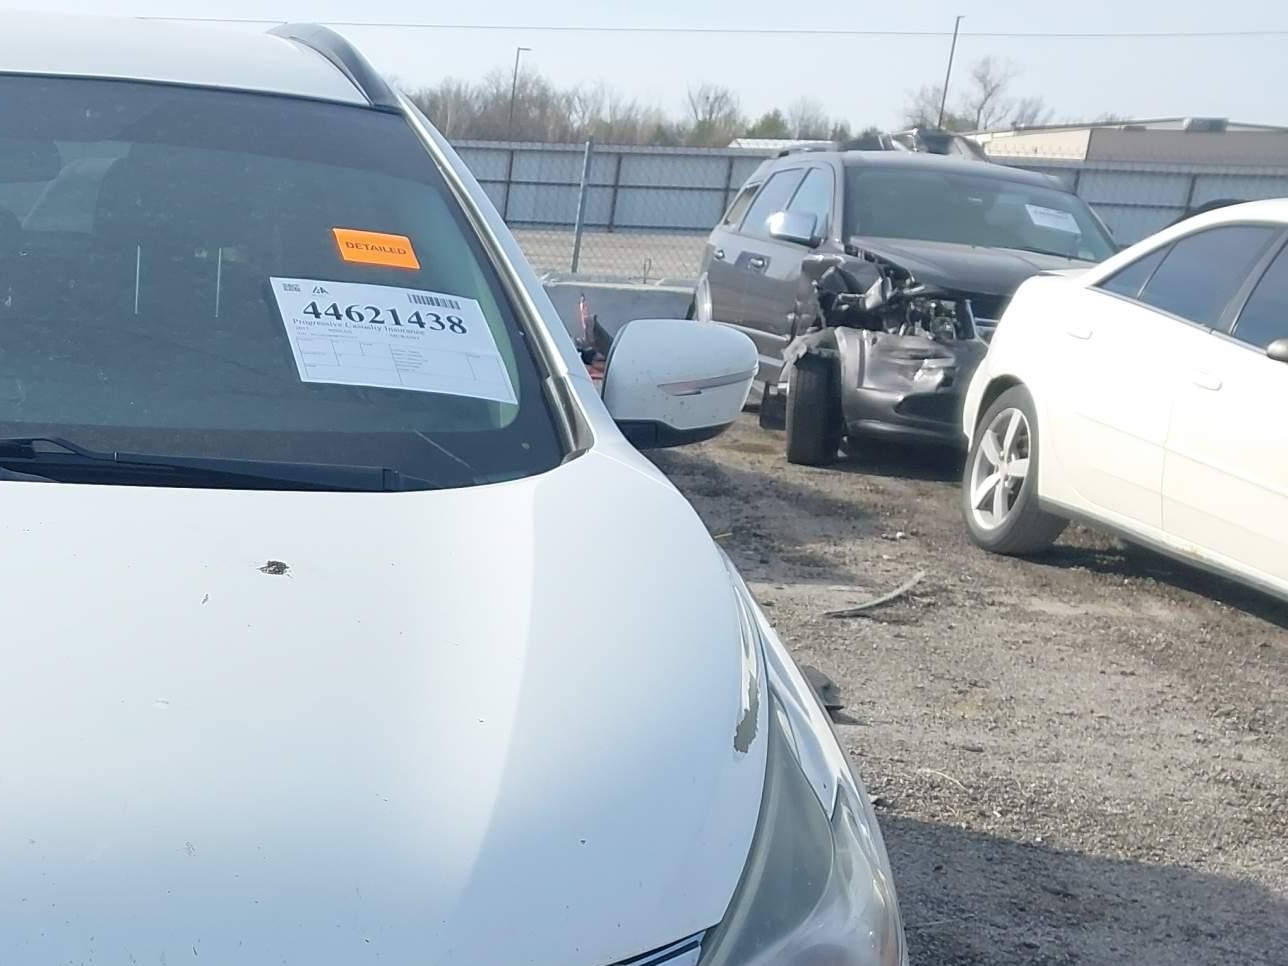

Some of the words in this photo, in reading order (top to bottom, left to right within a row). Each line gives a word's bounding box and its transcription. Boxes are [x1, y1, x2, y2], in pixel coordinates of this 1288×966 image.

[345, 241, 407, 255] DETAILED
[303, 300, 468, 335] 44621438
[292, 318, 342, 329] Progressive
[345, 322, 382, 332] Casualty
